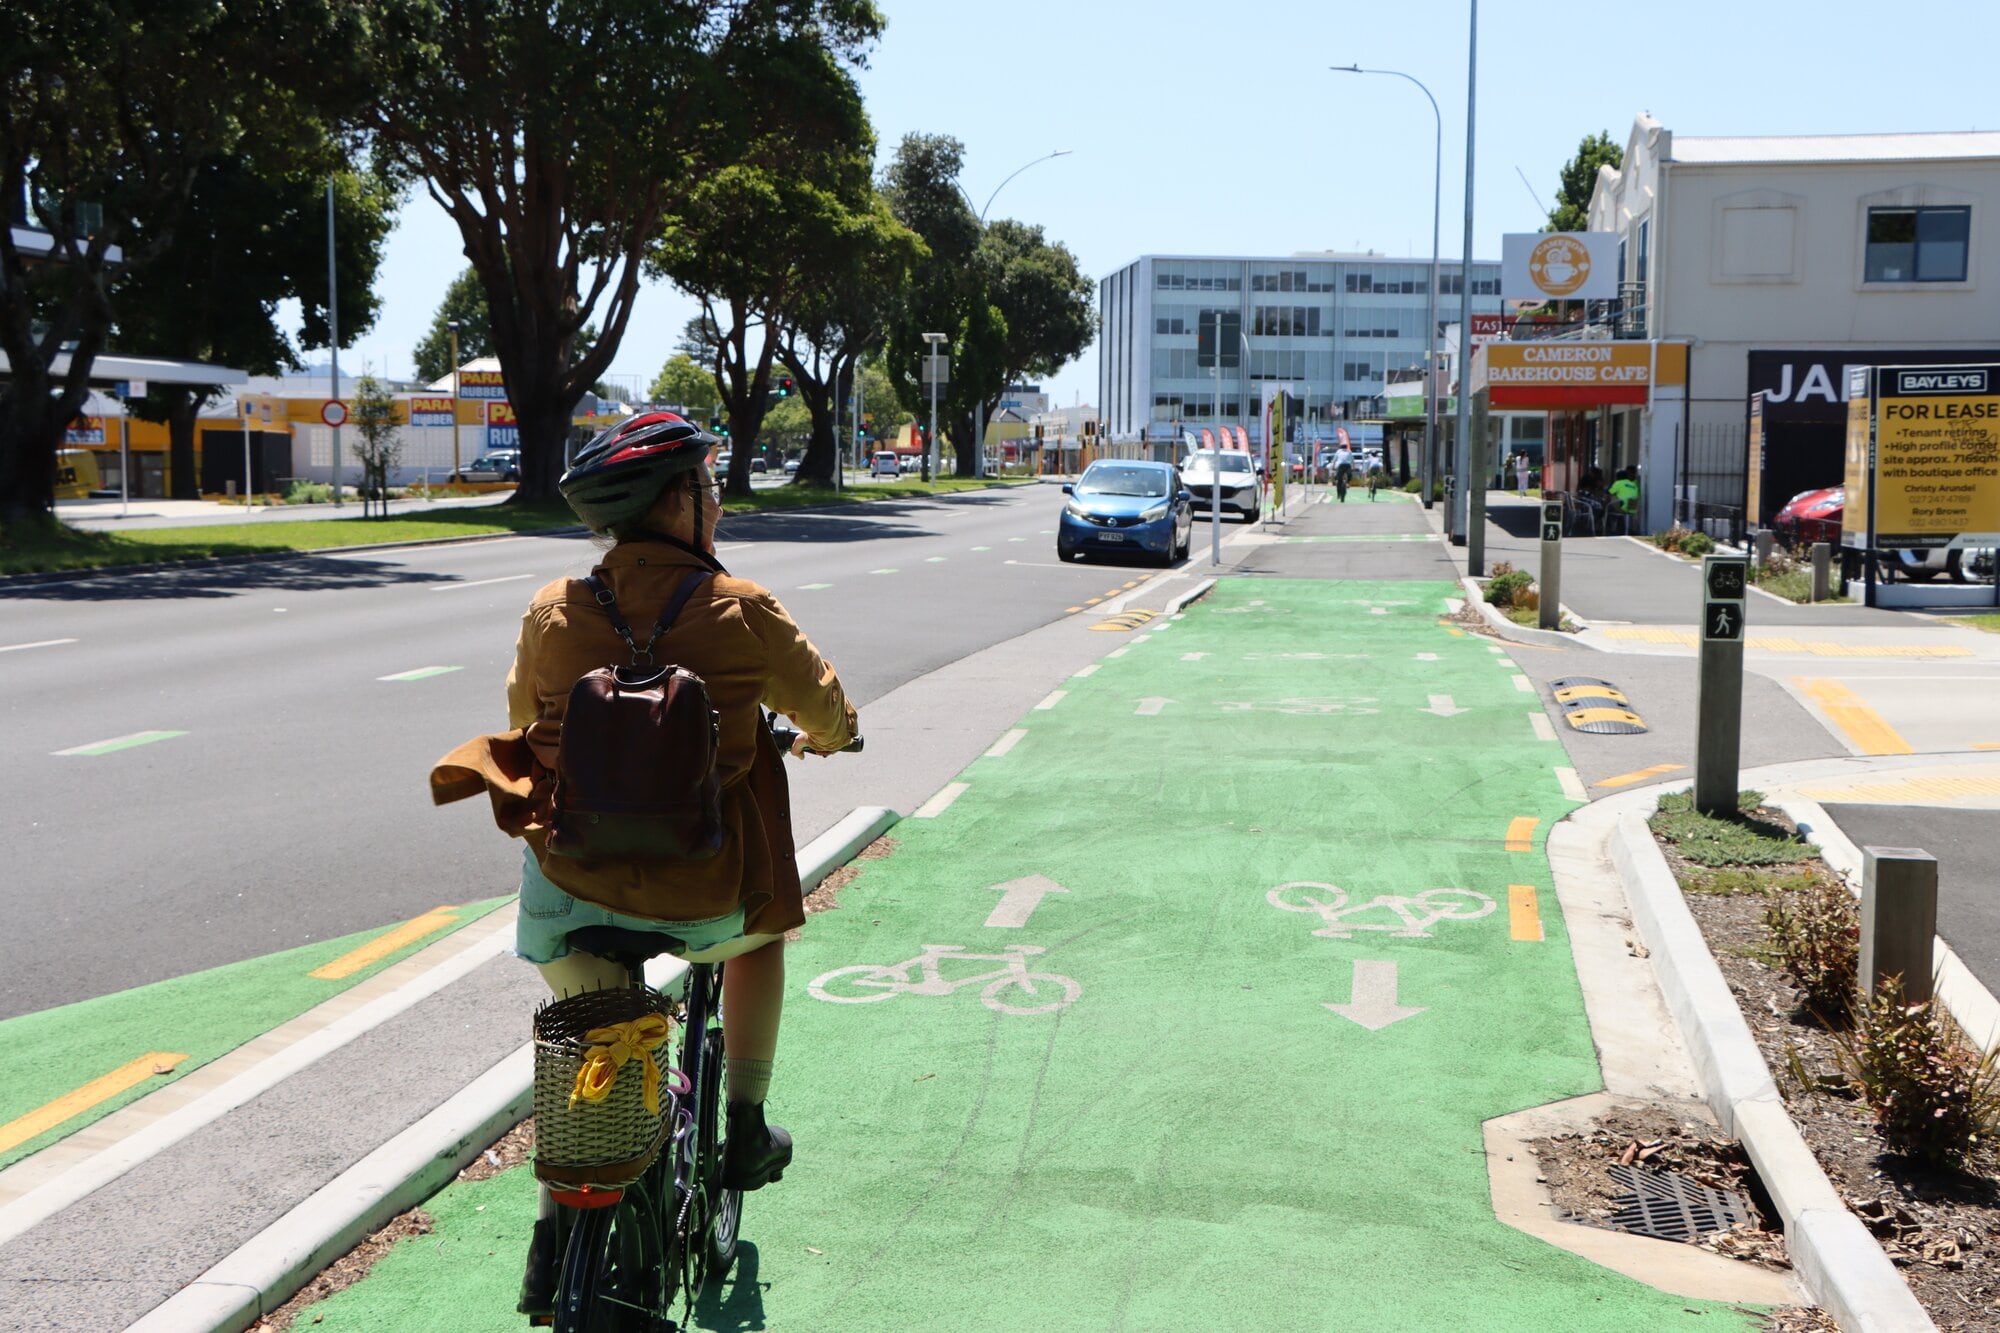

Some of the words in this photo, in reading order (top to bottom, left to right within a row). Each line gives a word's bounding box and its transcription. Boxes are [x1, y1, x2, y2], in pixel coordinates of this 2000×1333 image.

[1523, 347, 1612, 362] CAMERON
[461, 373, 504, 384] PARA
[1489, 367, 1596, 381] BAKEHOUSE
[1601, 366, 1648, 380] CAFE
[1903, 375, 1982, 389] BAYLEYS
[461, 386, 505, 397] RUBBER
[413, 400, 452, 410] PARA
[1886, 405, 1929, 419] FOR
[1934, 403, 1999, 419] LEASE
[1902, 429, 1941, 438] Tenant
[1945, 428, 1987, 439] retiring
[1890, 442, 1917, 452] High
[1920, 441, 1957, 452] profile
[1960, 441, 1998, 450] corner
[1884, 456, 1904, 464] site
[1883, 468, 1907, 477] with
[1910, 467, 1962, 478] boutique
[1965, 467, 1998, 476] office
[1904, 484, 1936, 493] Christy
[1912, 508, 1934, 516] Rory
